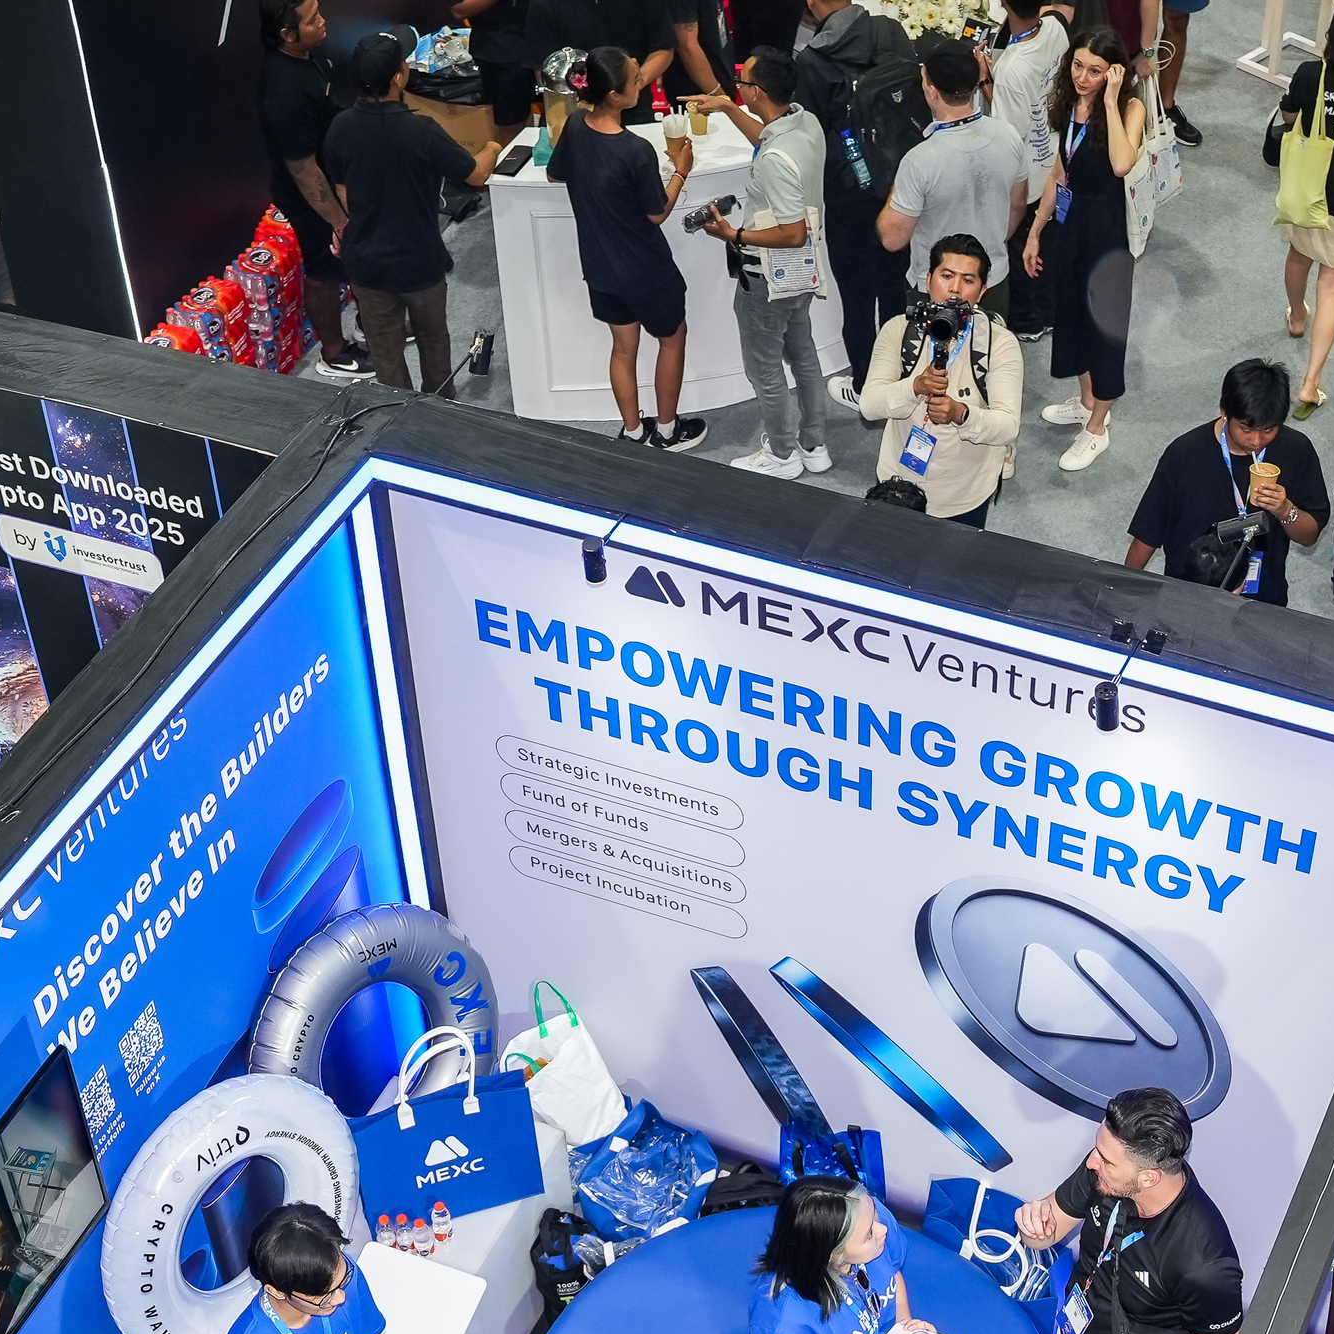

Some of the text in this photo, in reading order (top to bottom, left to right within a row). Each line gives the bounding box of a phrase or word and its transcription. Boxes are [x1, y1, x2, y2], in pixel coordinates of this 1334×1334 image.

[28, 456, 205, 518] Downloaded
[13, 529, 37, 551] by
[53, 493, 106, 528] App
[115, 509, 185, 546] 2025
[73, 545, 147, 573] investortrust
[701, 581, 890, 664] MEXC
[474, 599, 1317, 875] EMPOWERING GROWTH
[518, 748, 719, 816] Strategic Investments
[522, 784, 649, 832] Fund of Funds
[534, 677, 1246, 914] THROUGH SYNERGY
[33, 652, 330, 1028] Discover the Builders
[526, 821, 732, 892] Mergers & Acquisitions
[531, 856, 691, 914] Project Incubation
[98, 869, 205, 1010] Believe
[209, 828, 237, 876] In
[358, 938, 398, 963] MEXC
[295, 1014, 316, 1061] CRYPTO
[135, 1055, 166, 1096] Follow us
[146, 1073, 161, 1094] on X
[97, 1121, 126, 1162] portfolio
[107, 1111, 123, 1133] view
[265, 1130, 339, 1181] GROWTH THROUGH SYNERGY
[415, 1157, 485, 1189] MEXC
[140, 1203, 173, 1294] CRYPTO
